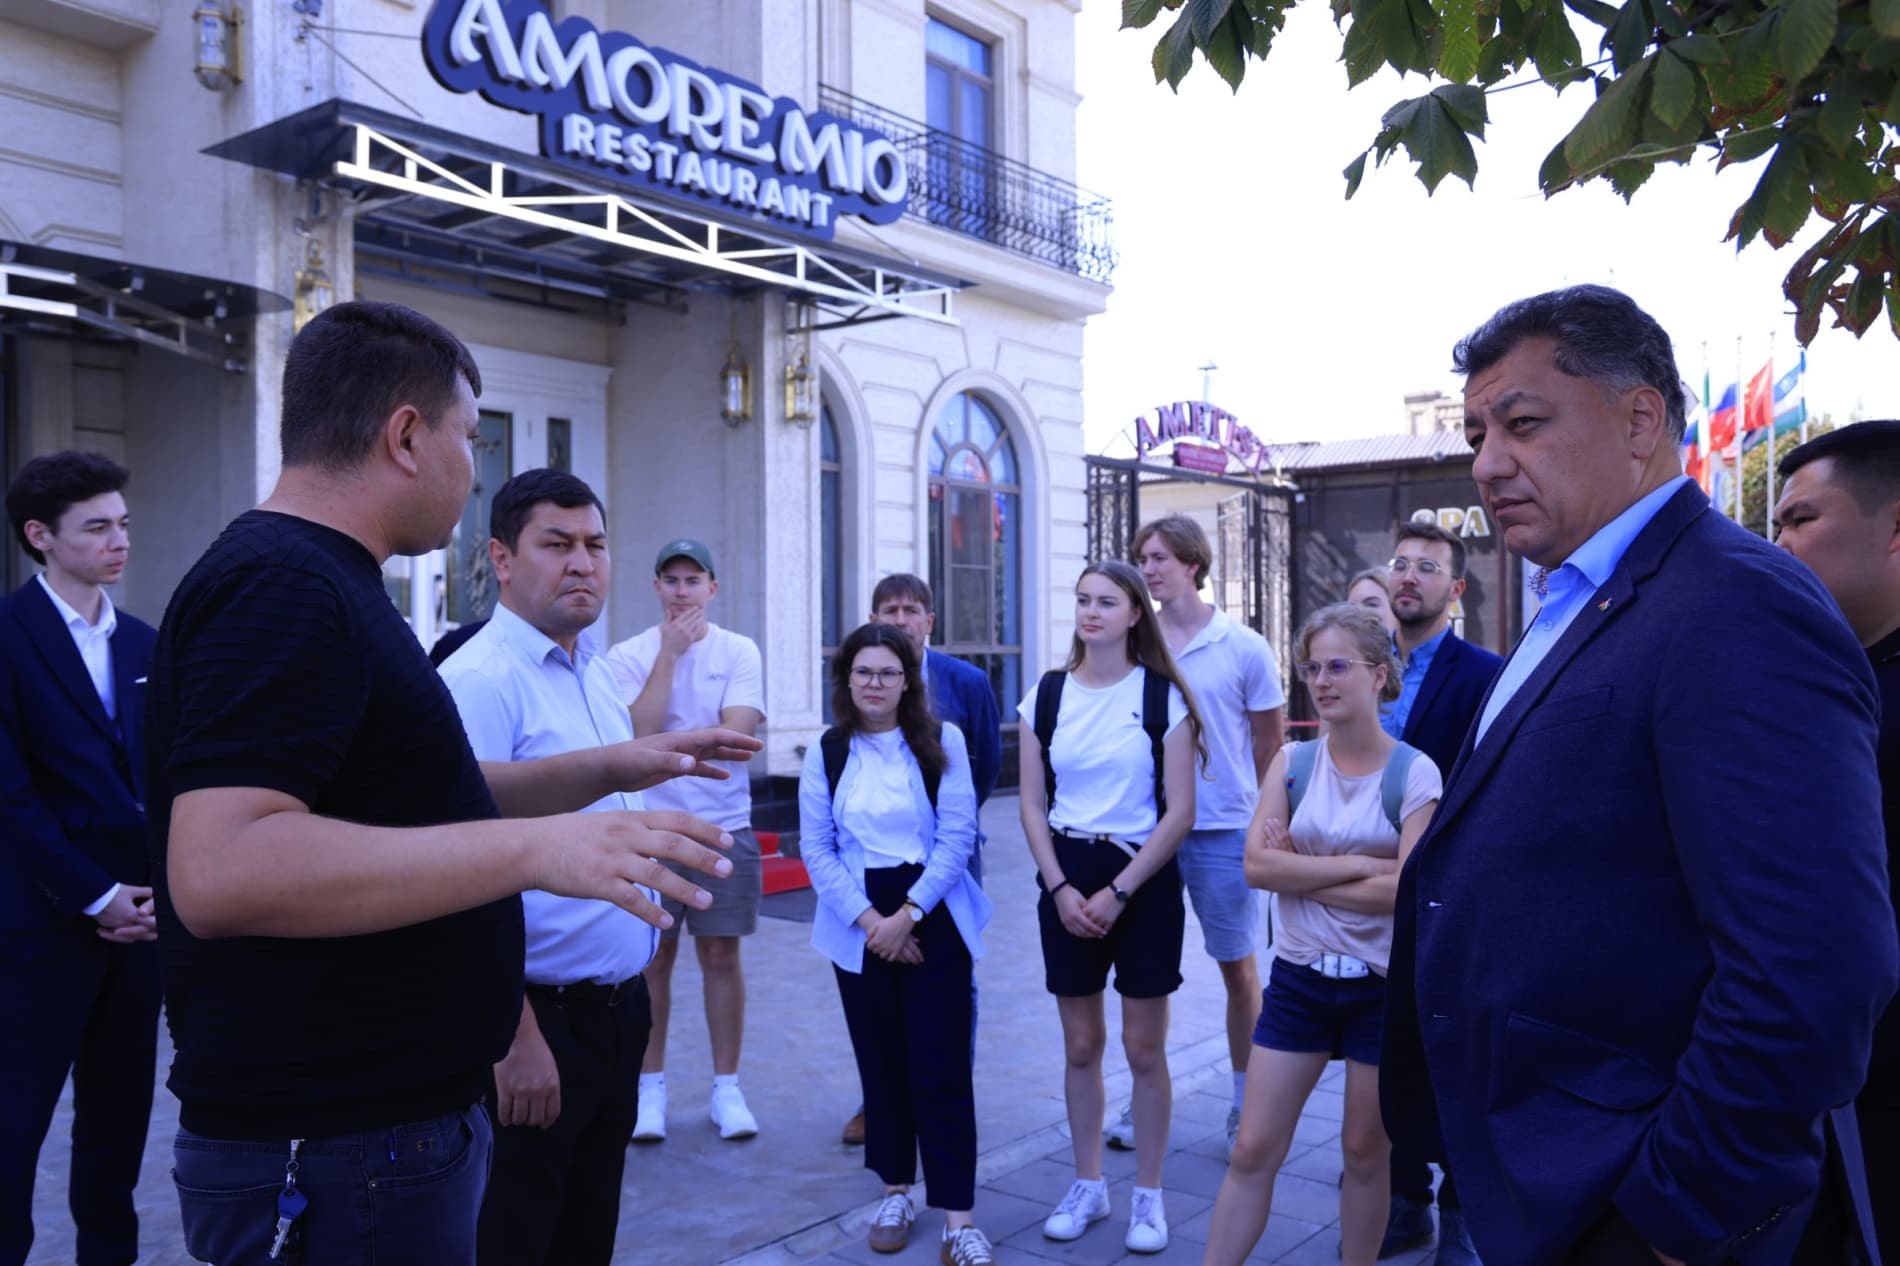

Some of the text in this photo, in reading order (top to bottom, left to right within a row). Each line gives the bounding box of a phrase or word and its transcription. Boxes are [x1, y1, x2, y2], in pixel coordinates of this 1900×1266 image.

[450, 0, 908, 204] AMORE MIO
[562, 113, 832, 228] RESTAURANT
